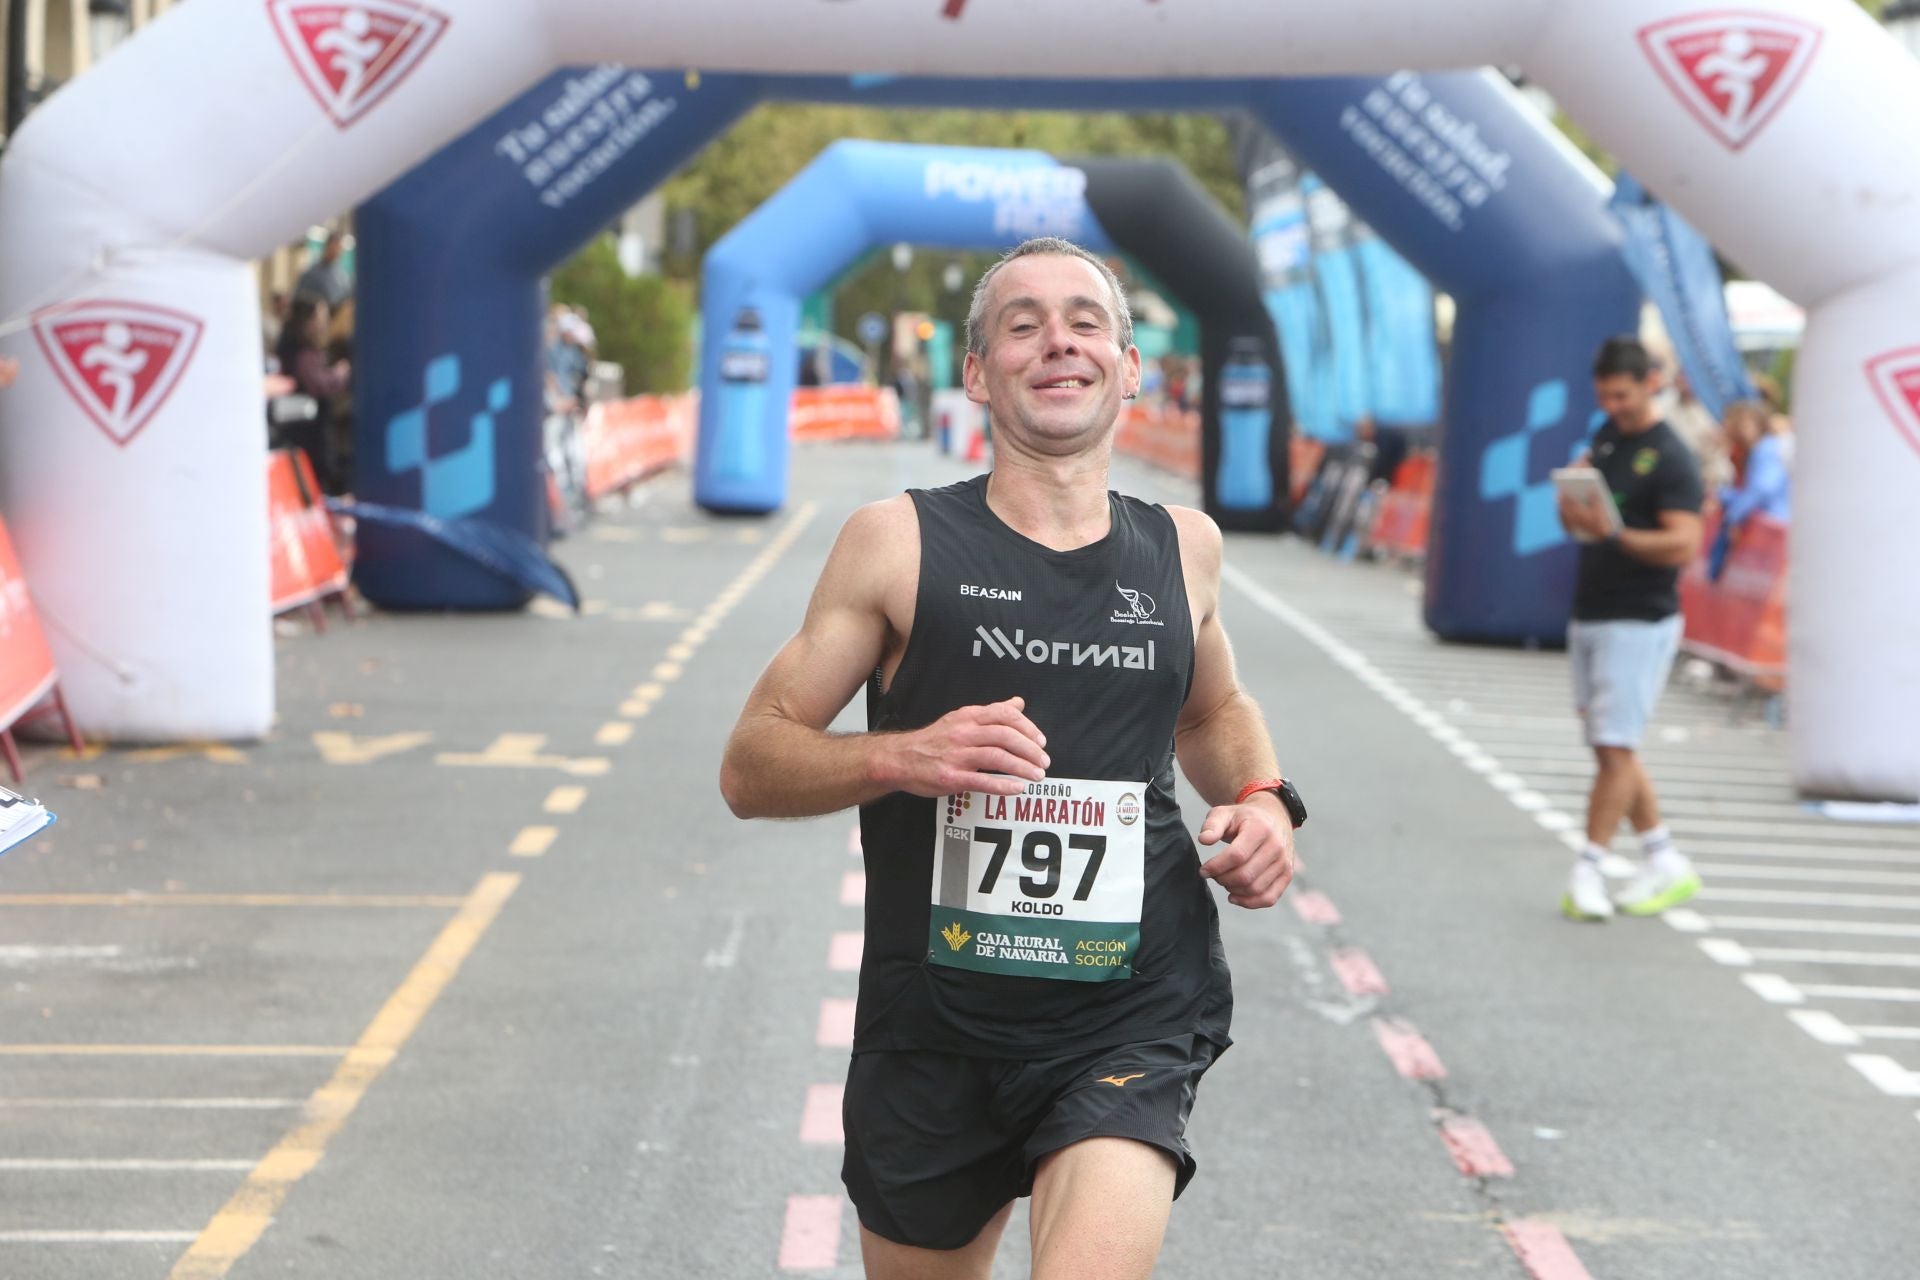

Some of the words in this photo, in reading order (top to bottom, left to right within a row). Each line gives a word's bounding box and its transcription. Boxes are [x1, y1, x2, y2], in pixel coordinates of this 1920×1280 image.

[960, 584, 1022, 601] BEASAIN
[972, 624, 1155, 671] Normal
[1022, 783, 1072, 798] LOGROÑO
[984, 795, 1007, 821] LA
[1014, 796, 1105, 827] MARATÓN
[945, 827, 969, 841] 42K
[974, 826, 1107, 902] 797
[1011, 901, 1064, 916] KOLDO
[976, 932, 1011, 947] CAJA
[1014, 935, 1063, 951] RURAL
[1075, 939, 1126, 953] ACCIÓN
[975, 944, 995, 957] DE
[999, 949, 1069, 965] NAVARRA
[1075, 954, 1124, 967] SOCIAL
